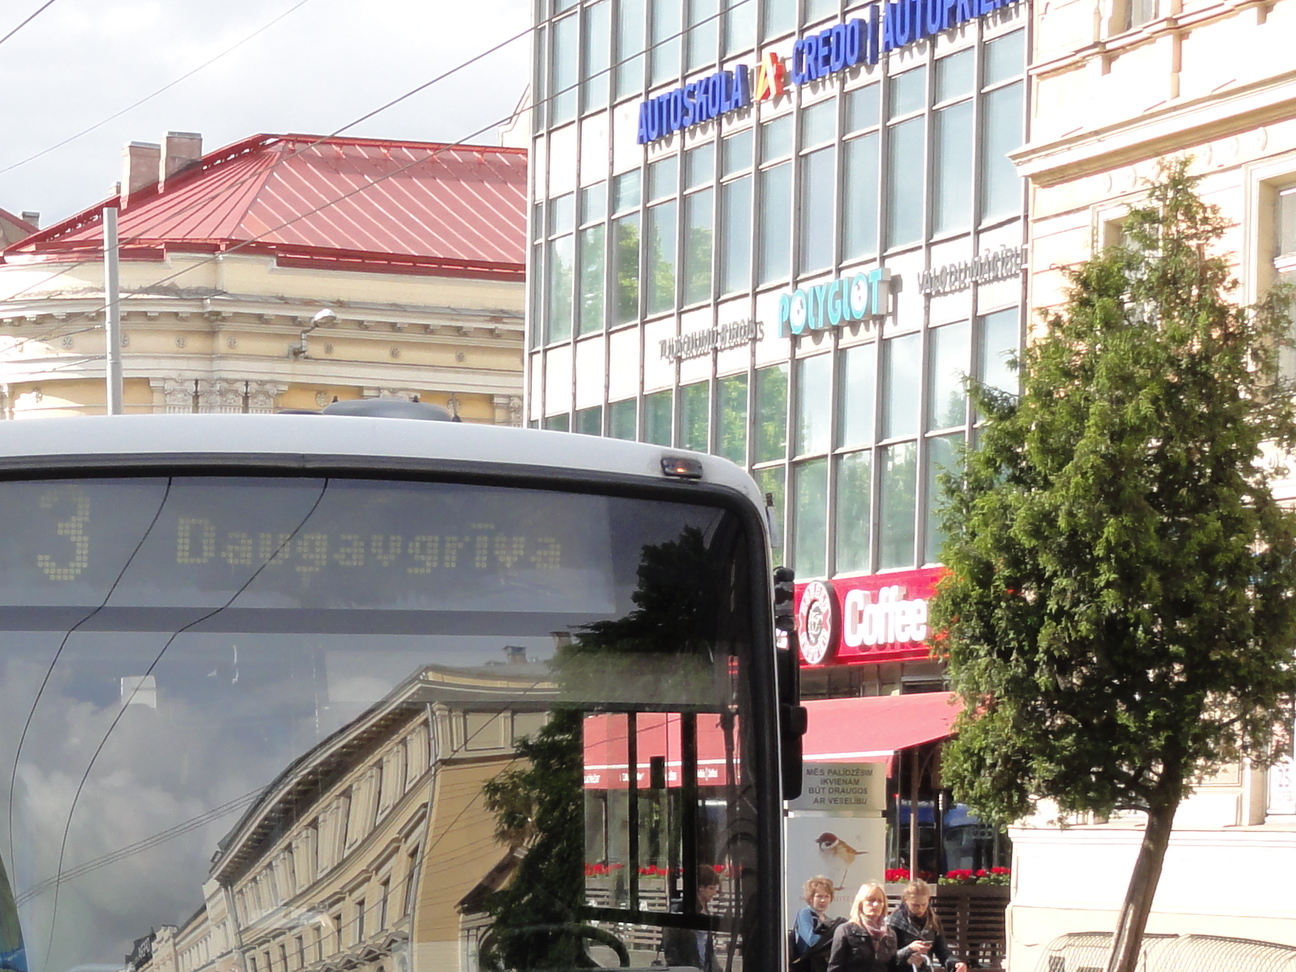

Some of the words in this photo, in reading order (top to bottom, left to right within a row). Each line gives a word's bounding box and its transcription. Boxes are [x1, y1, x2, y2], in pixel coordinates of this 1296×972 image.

[637, 64, 750, 145] AUTOSKOLA
[791, 18, 867, 86] CREDO
[778, 267, 892, 338] POLYGLOT
[37, 486, 90, 581] 3
[844, 585, 929, 648] Coffee
[820, 778, 860, 786] IKVIENAM
